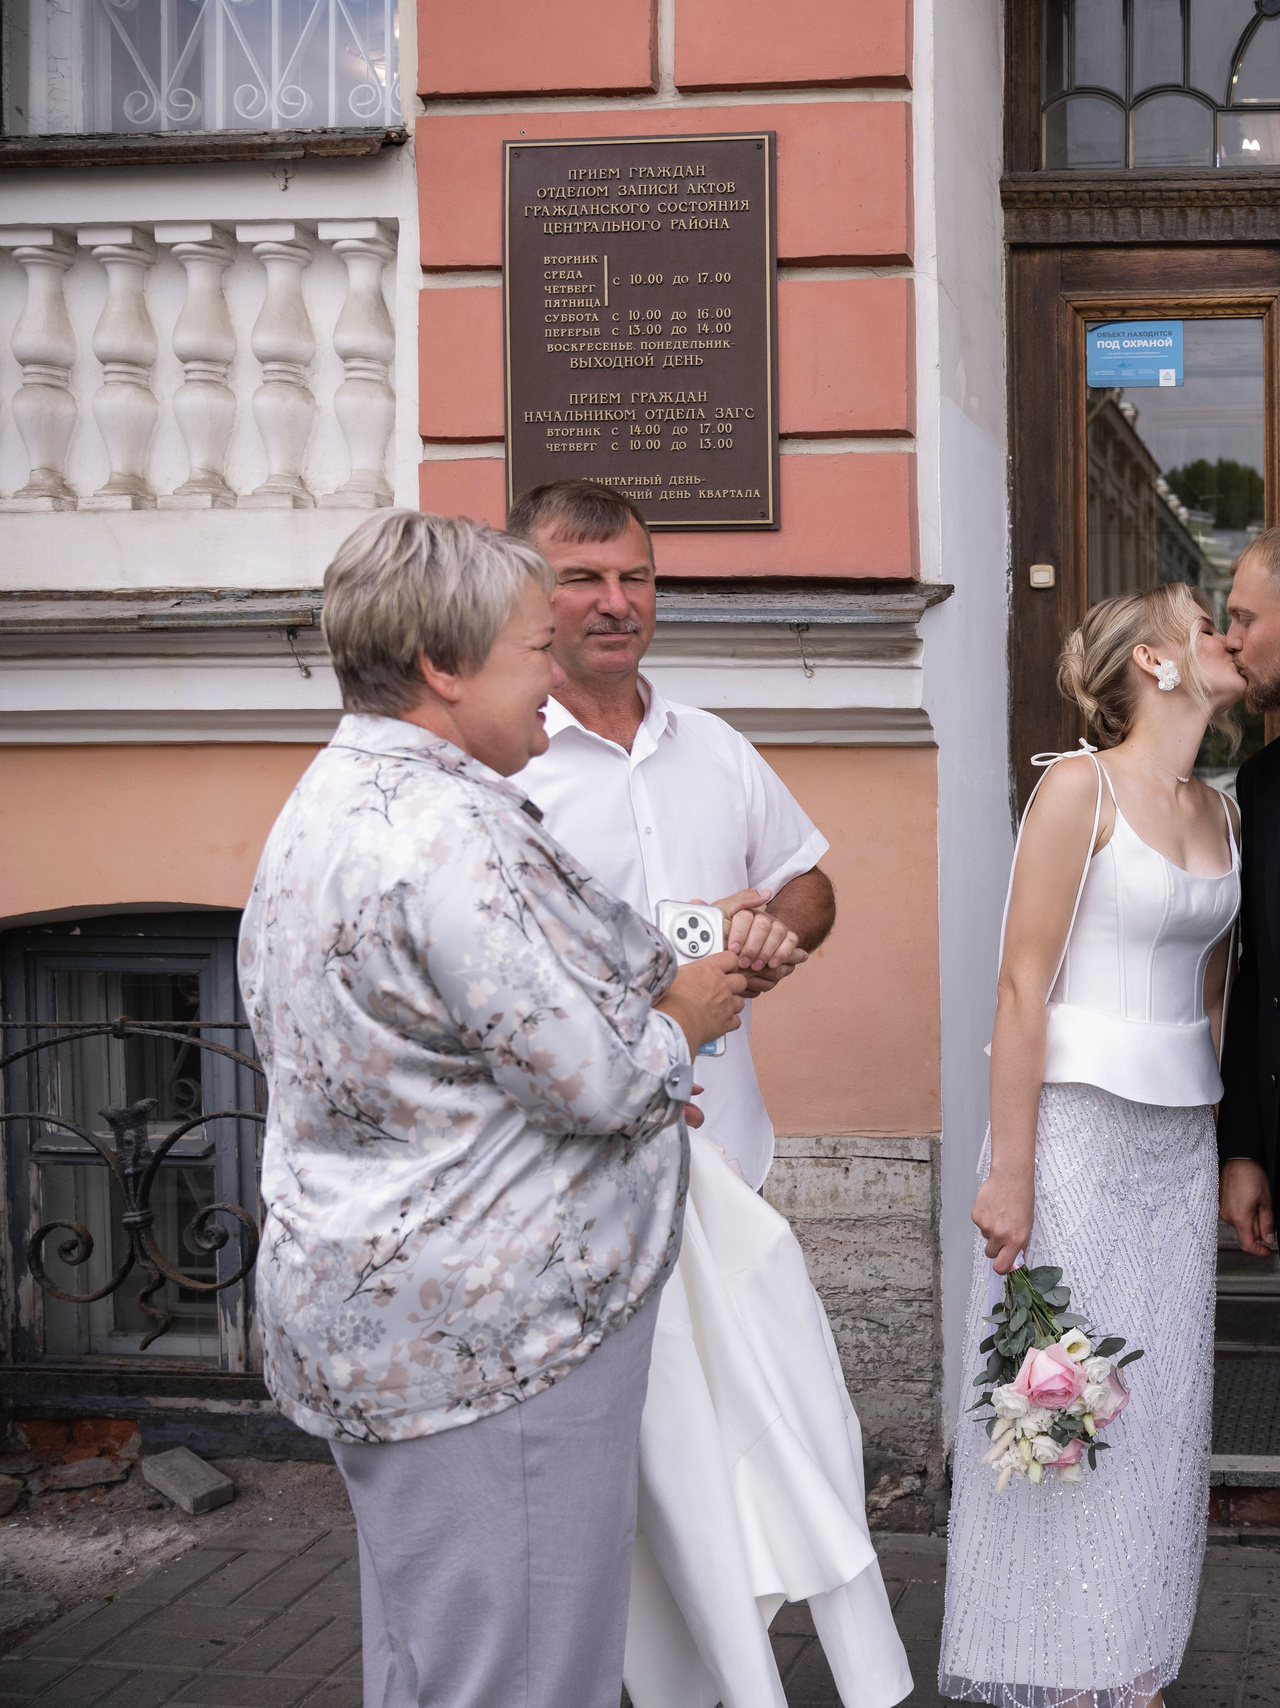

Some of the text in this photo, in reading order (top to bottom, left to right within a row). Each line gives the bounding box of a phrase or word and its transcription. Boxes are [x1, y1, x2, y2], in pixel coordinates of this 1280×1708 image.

[569, 165, 705, 179] ПРИЕМ ГРАЖДАН
[537, 182, 735, 199] ОТДЕЛОМ ЗАПИСИ АКТОВ
[525, 200, 748, 216] ГРАЖДАНСКОГО СОСТОЯНИЯ
[544, 216, 729, 234] ЦЕНТРАЛЬНОГО РАЙОНА
[544, 255, 598, 264] ВТОРНИК
[544, 271, 582, 279] СРЕДА
[631, 274, 663, 284] 10.00
[699, 273, 731, 282] 17.00
[545, 285, 596, 293] ЧЕТВЕРГ
[545, 299, 600, 308] ПЯТНИЦА
[545, 314, 598, 322] СУББОТА
[629, 310, 661, 320] 10.00
[698, 308, 731, 318] 16.00
[545, 328, 600, 337] ПЕРЕРЫВ
[629, 324, 661, 335] 13.00
[698, 323, 731, 333] 14.00
[1097, 338, 1172, 349] ПОД ОХРАНОЙ
[570, 353, 703, 368] ВЫХОДНОЙ ДЕНЬ
[570, 392, 706, 404] ПРИЕМ ГРАЖДАН
[524, 408, 754, 422] НАЧАЛЬНИКОМ ОТДЕЛА ЗАГС
[547, 428, 600, 436] ВТОРНИК
[630, 424, 660, 435] 14.00
[700, 423, 732, 433] 17.00
[546, 443, 597, 451] ЧЕТВЕРГ
[631, 440, 660, 450] 10.00
[700, 438, 732, 448] 13.00
[659, 490, 690, 500] ДЕНЬ
[699, 490, 760, 498] КВАРТАЛА
